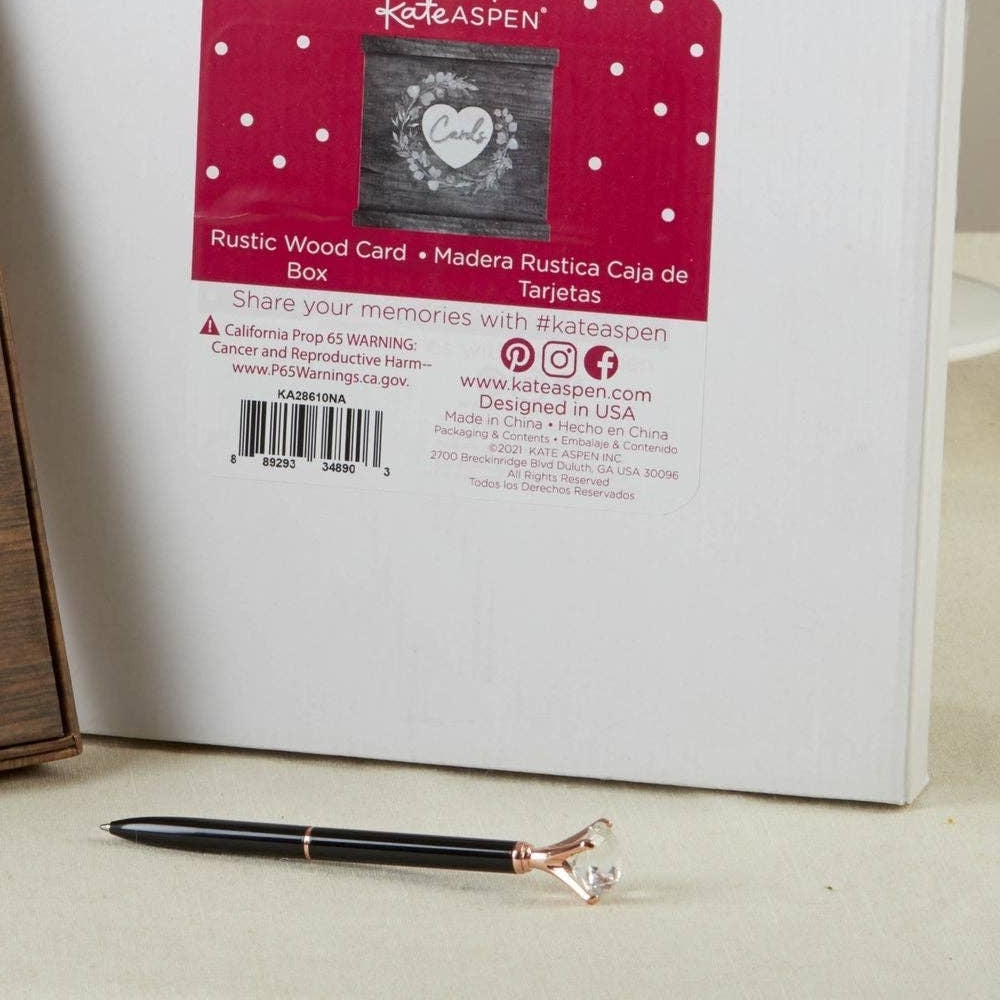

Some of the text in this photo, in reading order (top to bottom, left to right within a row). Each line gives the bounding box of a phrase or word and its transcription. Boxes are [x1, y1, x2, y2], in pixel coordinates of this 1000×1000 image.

[210, 229, 407, 261] Rustic Wood Card
[287, 261, 328, 282] Box
[434, 246, 688, 284] Madera Rustica Caja de
[518, 279, 601, 304] Tarjetas
[232, 289, 667, 342] Share your memories with #kateaspen
[225, 323, 289, 341] California
[292, 328, 324, 345] Prop
[327, 332, 343, 345] 65
[347, 333, 417, 351] WARNING:
[211, 340, 258, 357] Cancer
[261, 344, 287, 359] and
[291, 347, 381, 367] Reproductive
[232, 363, 410, 388] www.P65Warnings.ca.gov.
[460, 375, 652, 403] www.kateaspen.com
[277, 388, 347, 404] KA28610NA
[479, 394, 636, 421] Designed in USA
[445, 410, 669, 441] Made in China Hecho en China
[434, 425, 679, 455] Packaging & Contents Embalaje & Contenido
[230, 454, 391, 477] 8 89293 34890 3
[430, 451, 458, 463] 2700
[461, 453, 528, 468] Breckinridge
[531, 458, 554, 470] Blvd
[597, 464, 614, 475] GA
[617, 465, 640, 477] USA
[644, 468, 680, 480] 30096
[528, 446, 558, 458] KATE
[561, 449, 599, 462] ASPEN
[469, 477, 636, 501] Todos los Derechos Reservados
[507, 469, 610, 487] All Rights Reserved
